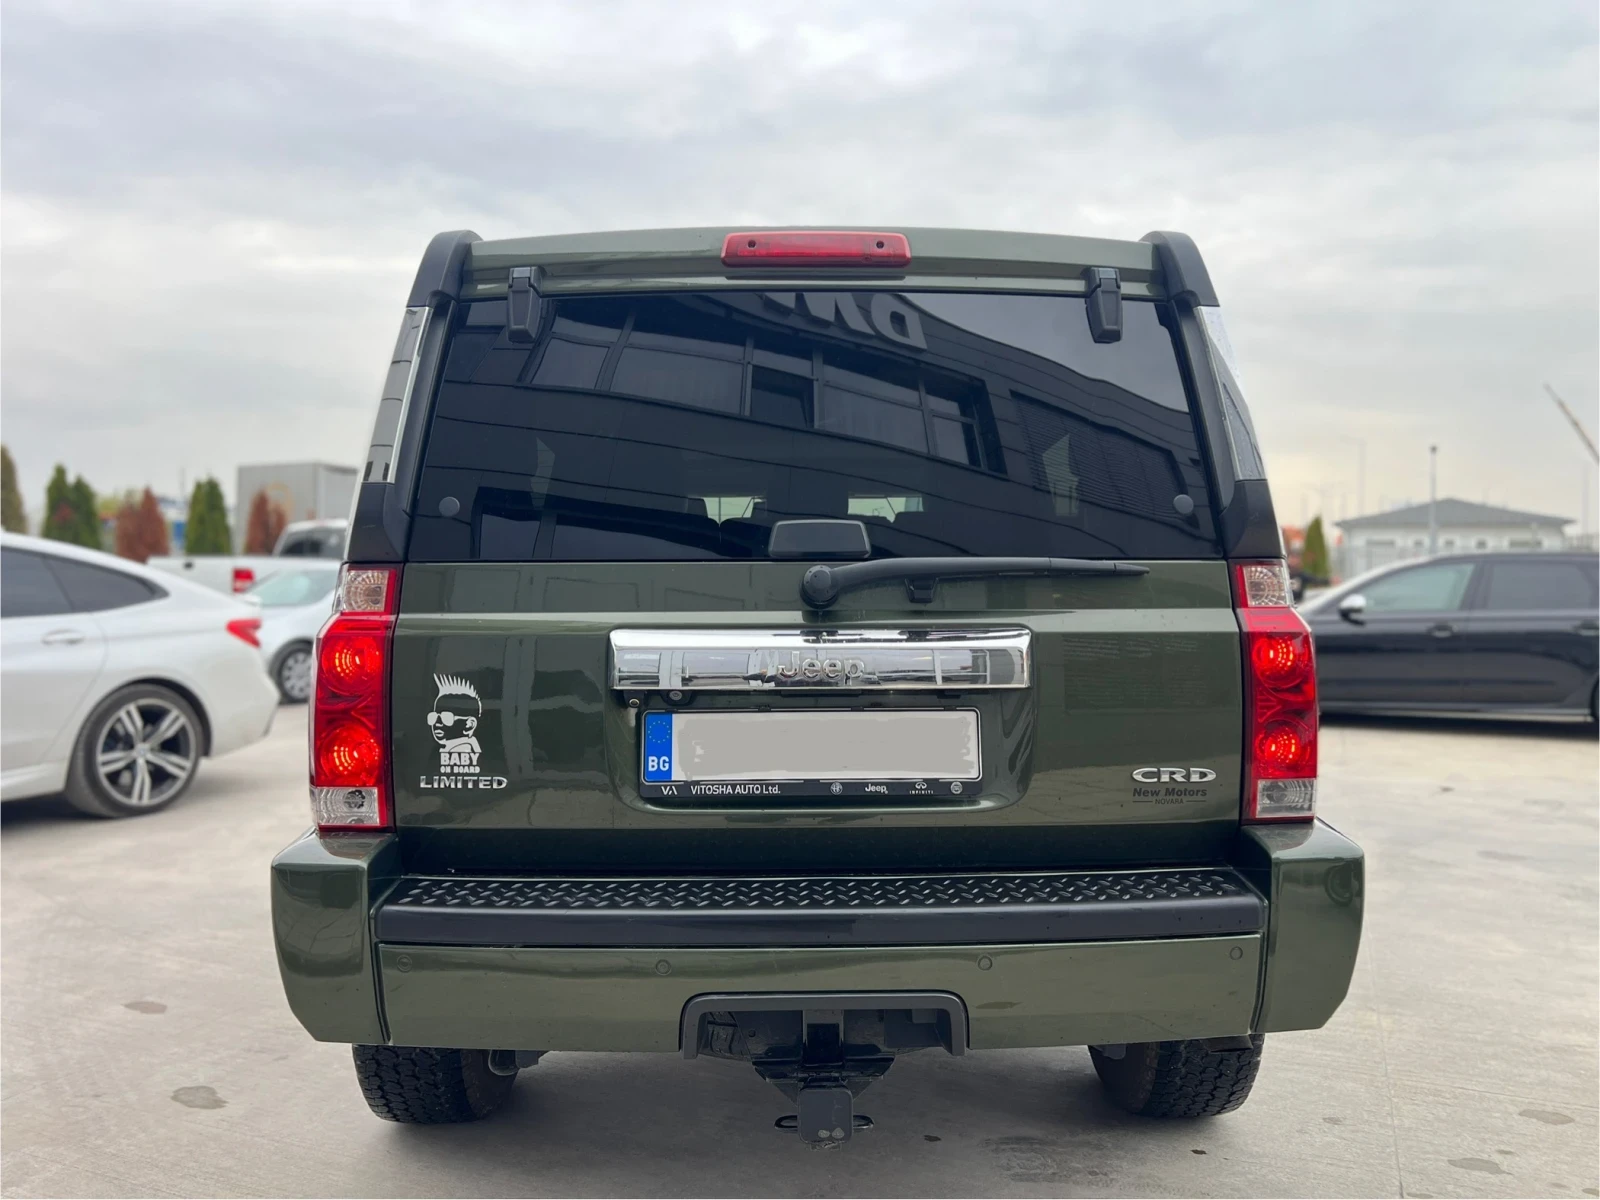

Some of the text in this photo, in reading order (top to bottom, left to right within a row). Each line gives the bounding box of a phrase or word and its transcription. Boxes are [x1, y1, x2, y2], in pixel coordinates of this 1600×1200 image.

[778, 651, 865, 686] Jeep
[440, 753, 480, 765] BABY
[648, 756, 669, 771] BG
[440, 766, 480, 774] ON BOARD
[1132, 767, 1217, 783] CRD
[420, 776, 508, 789] LIMITED
[690, 784, 733, 795] VITOSHA
[734, 784, 761, 795] AUTO
[762, 784, 781, 795] Ltd.
[865, 783, 888, 794] Jeep
[1132, 787, 1208, 797] New Motors
